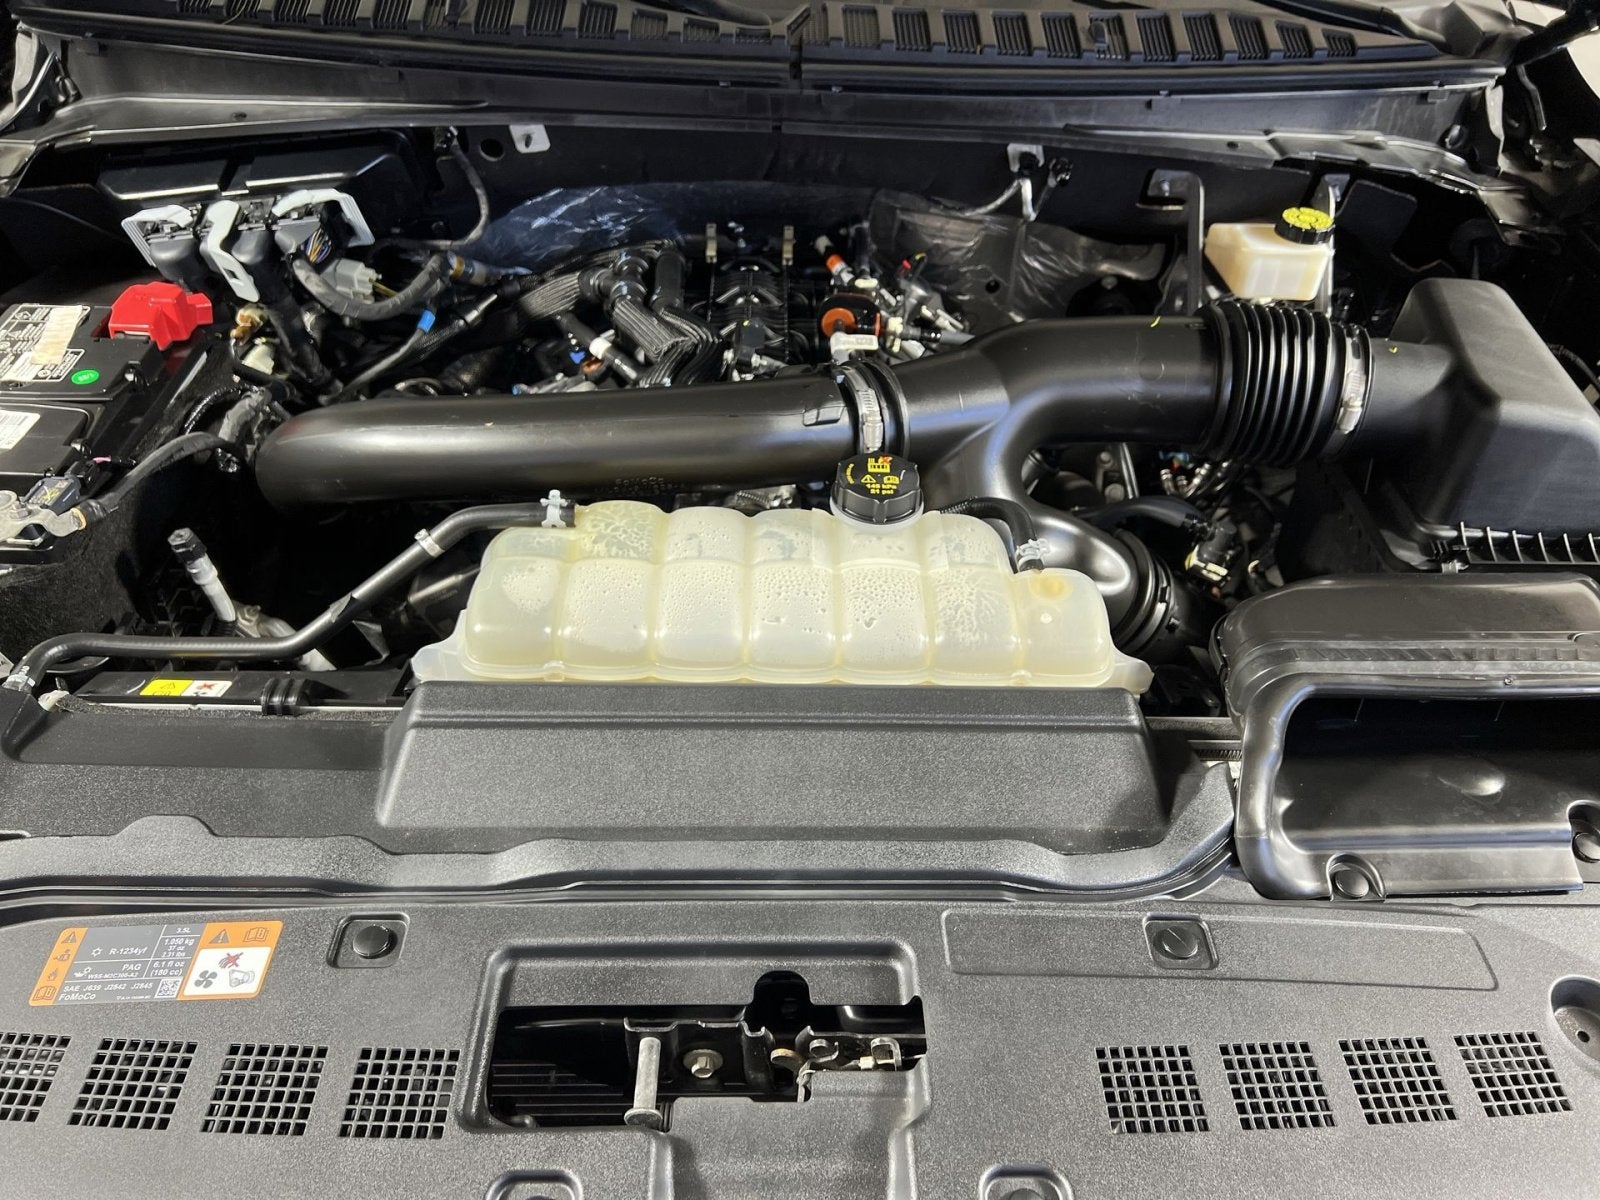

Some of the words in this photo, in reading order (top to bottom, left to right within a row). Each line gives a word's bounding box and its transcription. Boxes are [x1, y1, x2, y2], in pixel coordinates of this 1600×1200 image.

[108, 946, 148, 956] R-1234yf
[150, 968, 168, 976] (180
[58, 993, 96, 1001] FoMoCo
